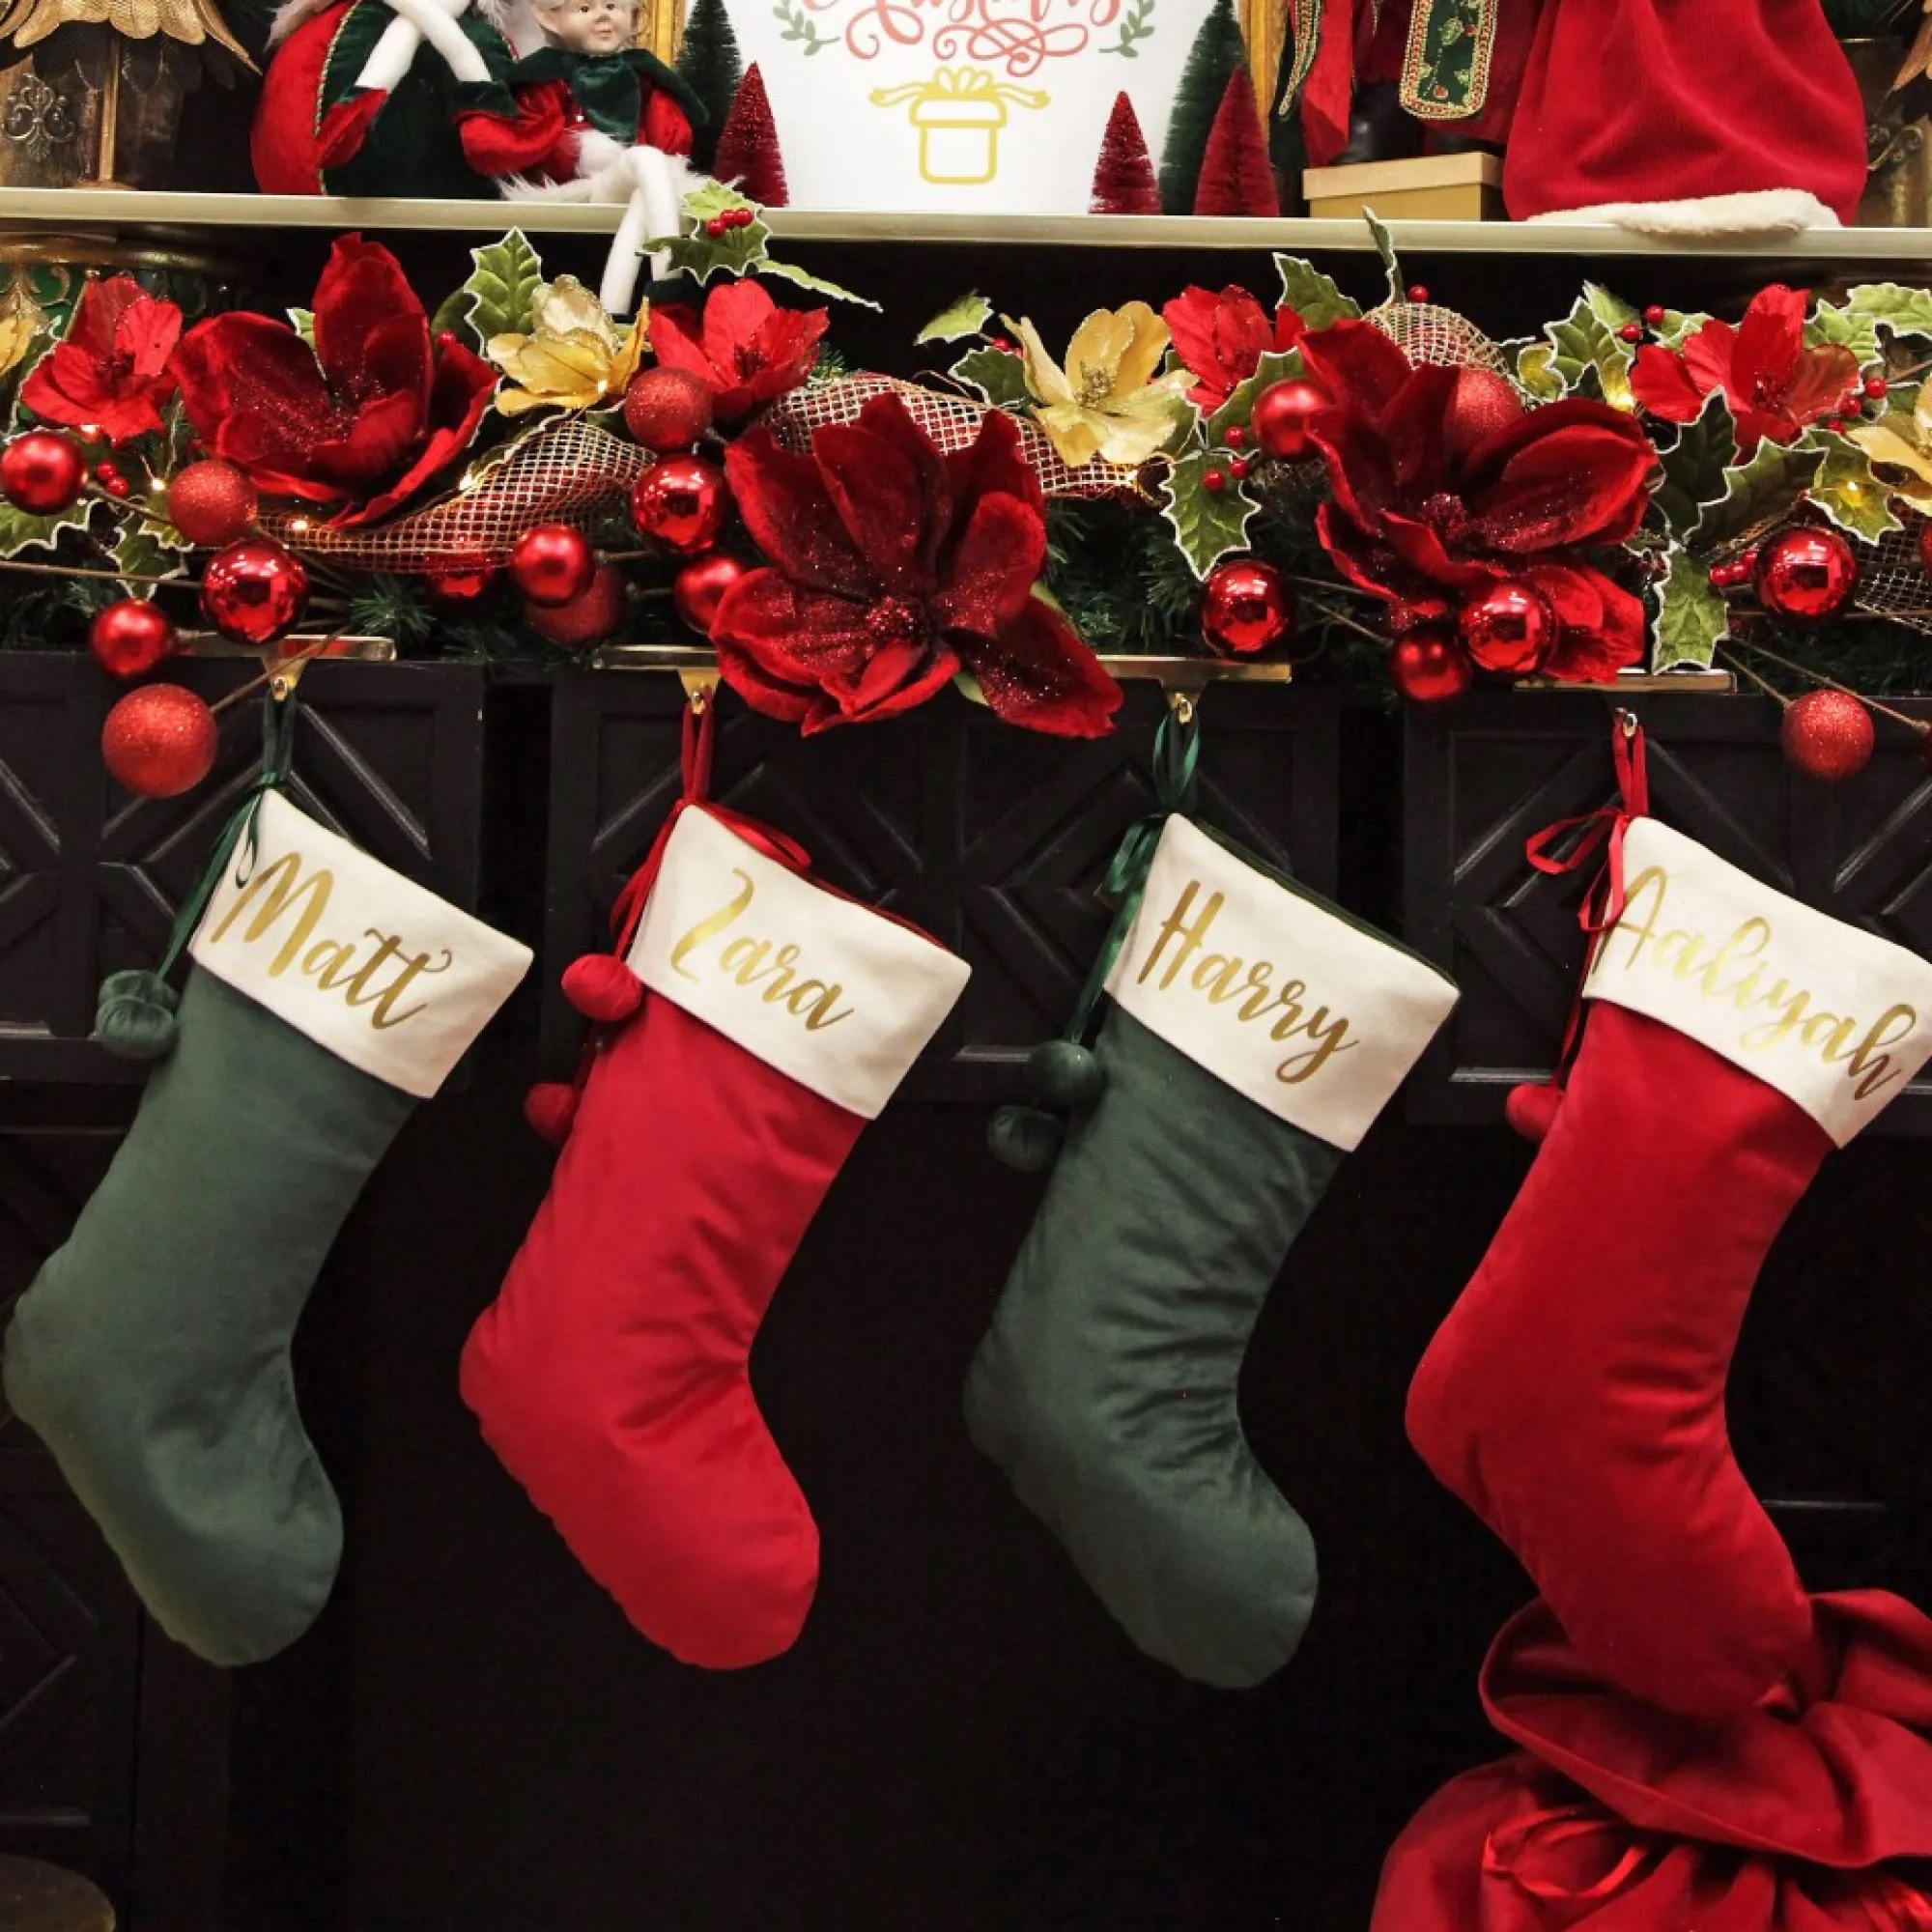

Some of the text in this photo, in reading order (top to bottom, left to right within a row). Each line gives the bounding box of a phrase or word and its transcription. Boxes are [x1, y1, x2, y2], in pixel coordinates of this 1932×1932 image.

[210, 851, 452, 1030] Matt
[670, 867, 855, 1031] Zara
[1137, 879, 1359, 1085] Harry
[1592, 866, 1918, 1101] Aaliyah
